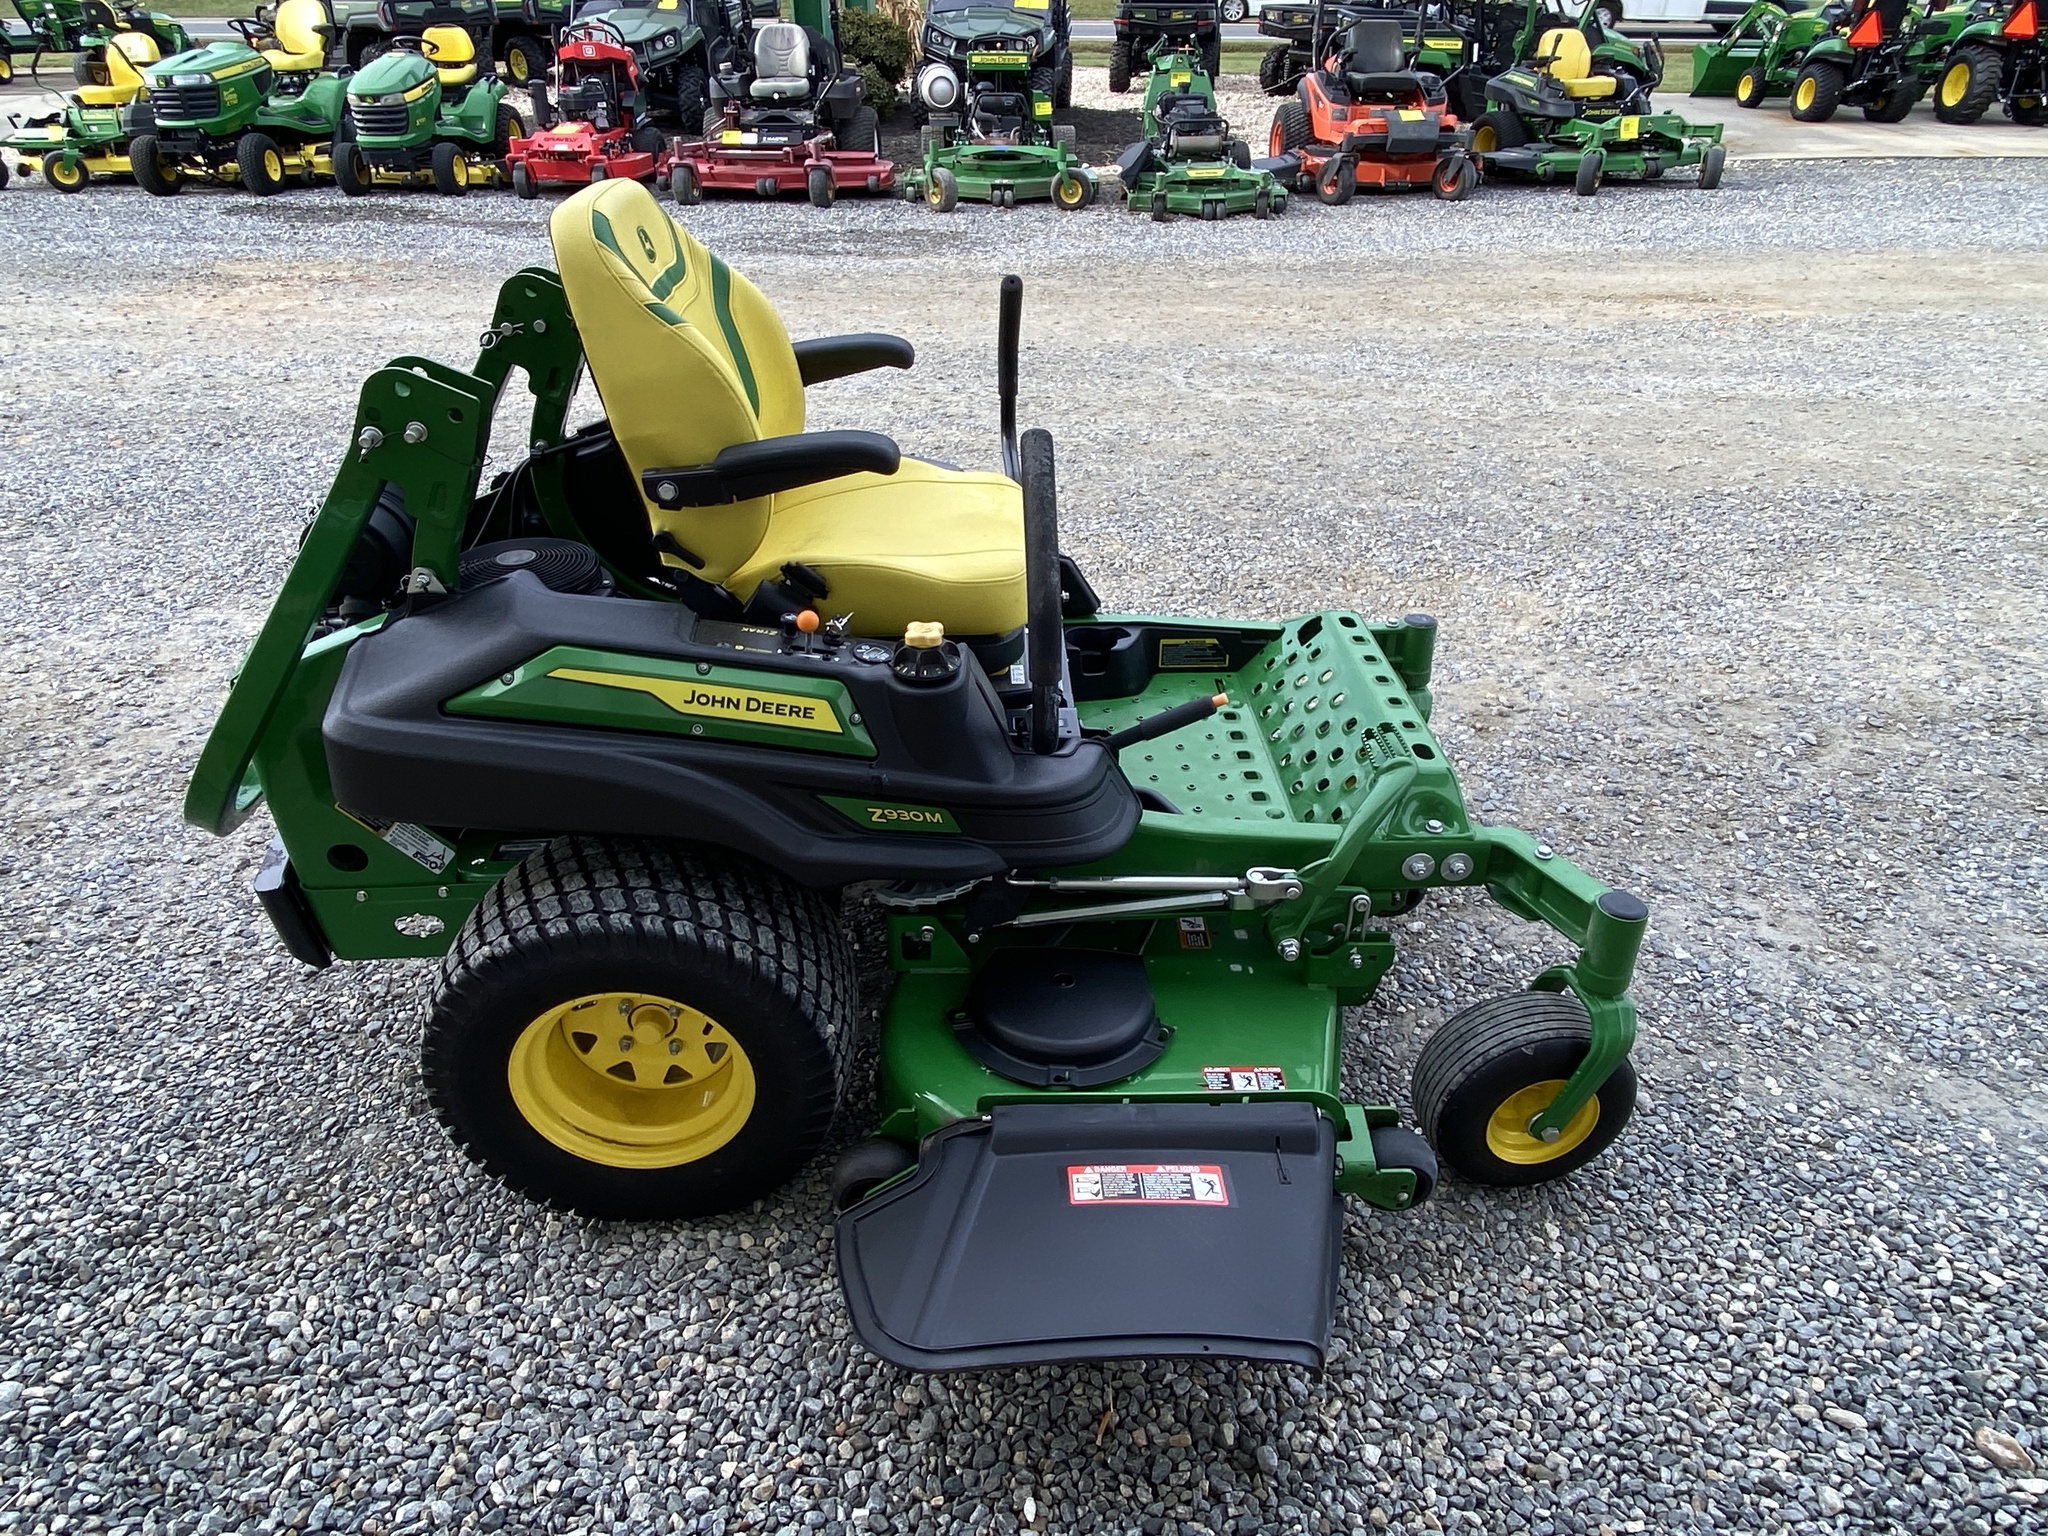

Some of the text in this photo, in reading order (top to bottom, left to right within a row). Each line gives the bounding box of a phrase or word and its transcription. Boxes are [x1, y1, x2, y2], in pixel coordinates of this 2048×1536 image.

[1585, 108, 1601, 116] JOHN
[684, 690, 816, 720] JOHN DEERE
[867, 808, 944, 824] Z930M
[1094, 1165, 1201, 1173] DANGER PELIGRO
